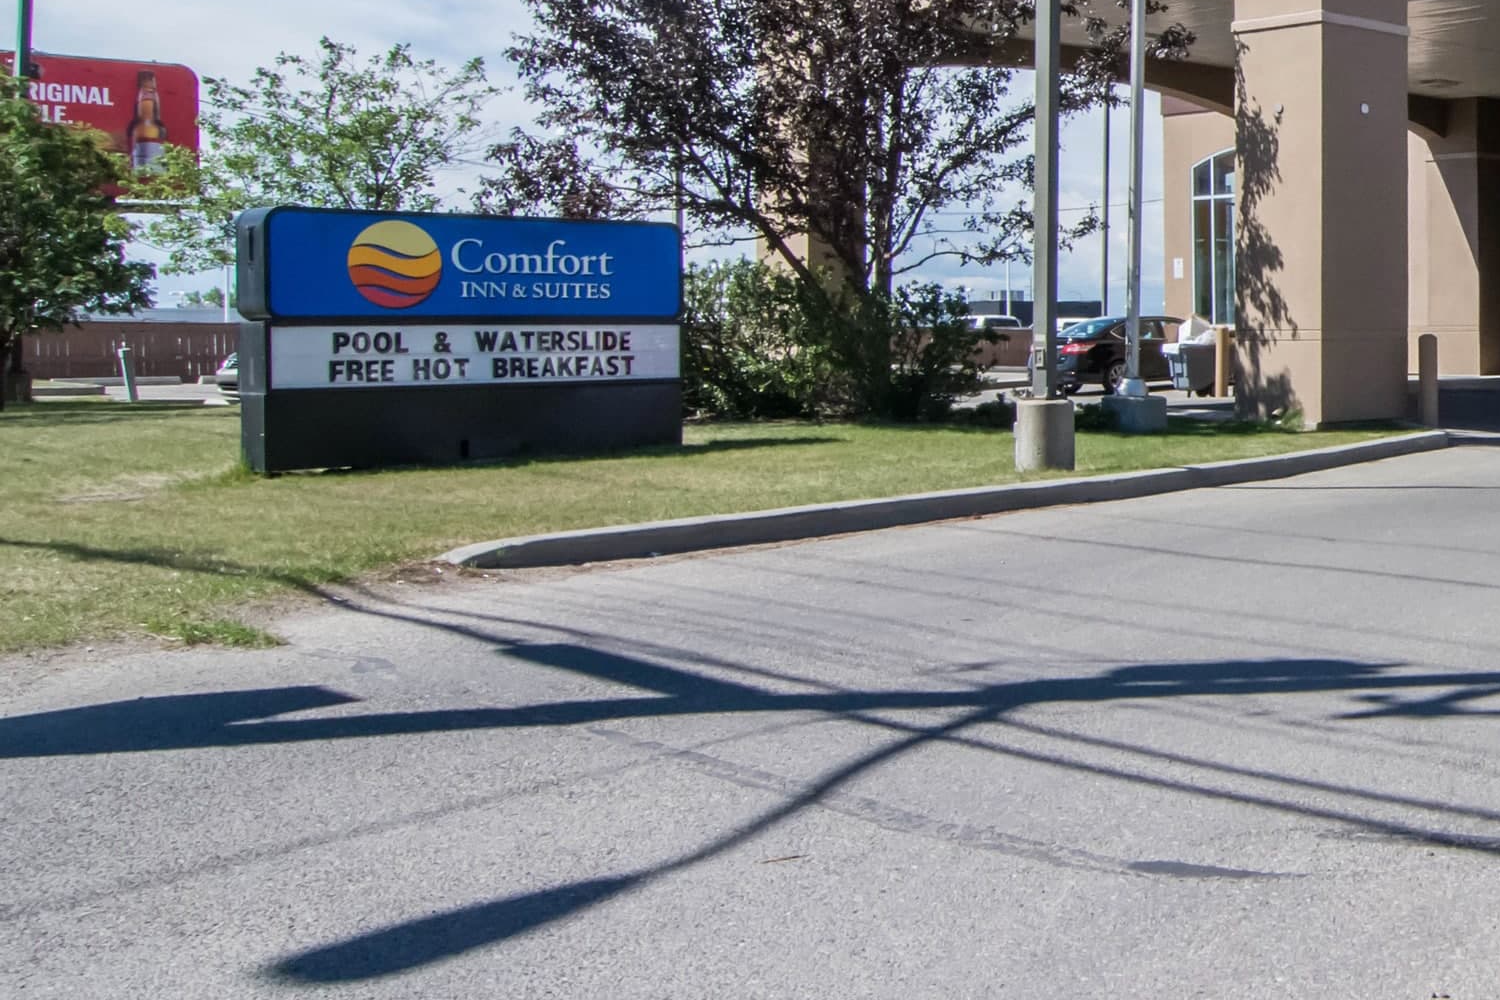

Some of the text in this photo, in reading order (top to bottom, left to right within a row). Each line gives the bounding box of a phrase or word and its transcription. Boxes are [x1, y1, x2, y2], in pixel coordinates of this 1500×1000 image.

[27, 81, 114, 106] RIGINAL
[451, 238, 614, 275] Comfort
[460, 281, 611, 299] INN & SUITES
[332, 331, 632, 354] POOL & WATERSLIDE
[328, 355, 636, 383] FREE HOT BREAKFAST
